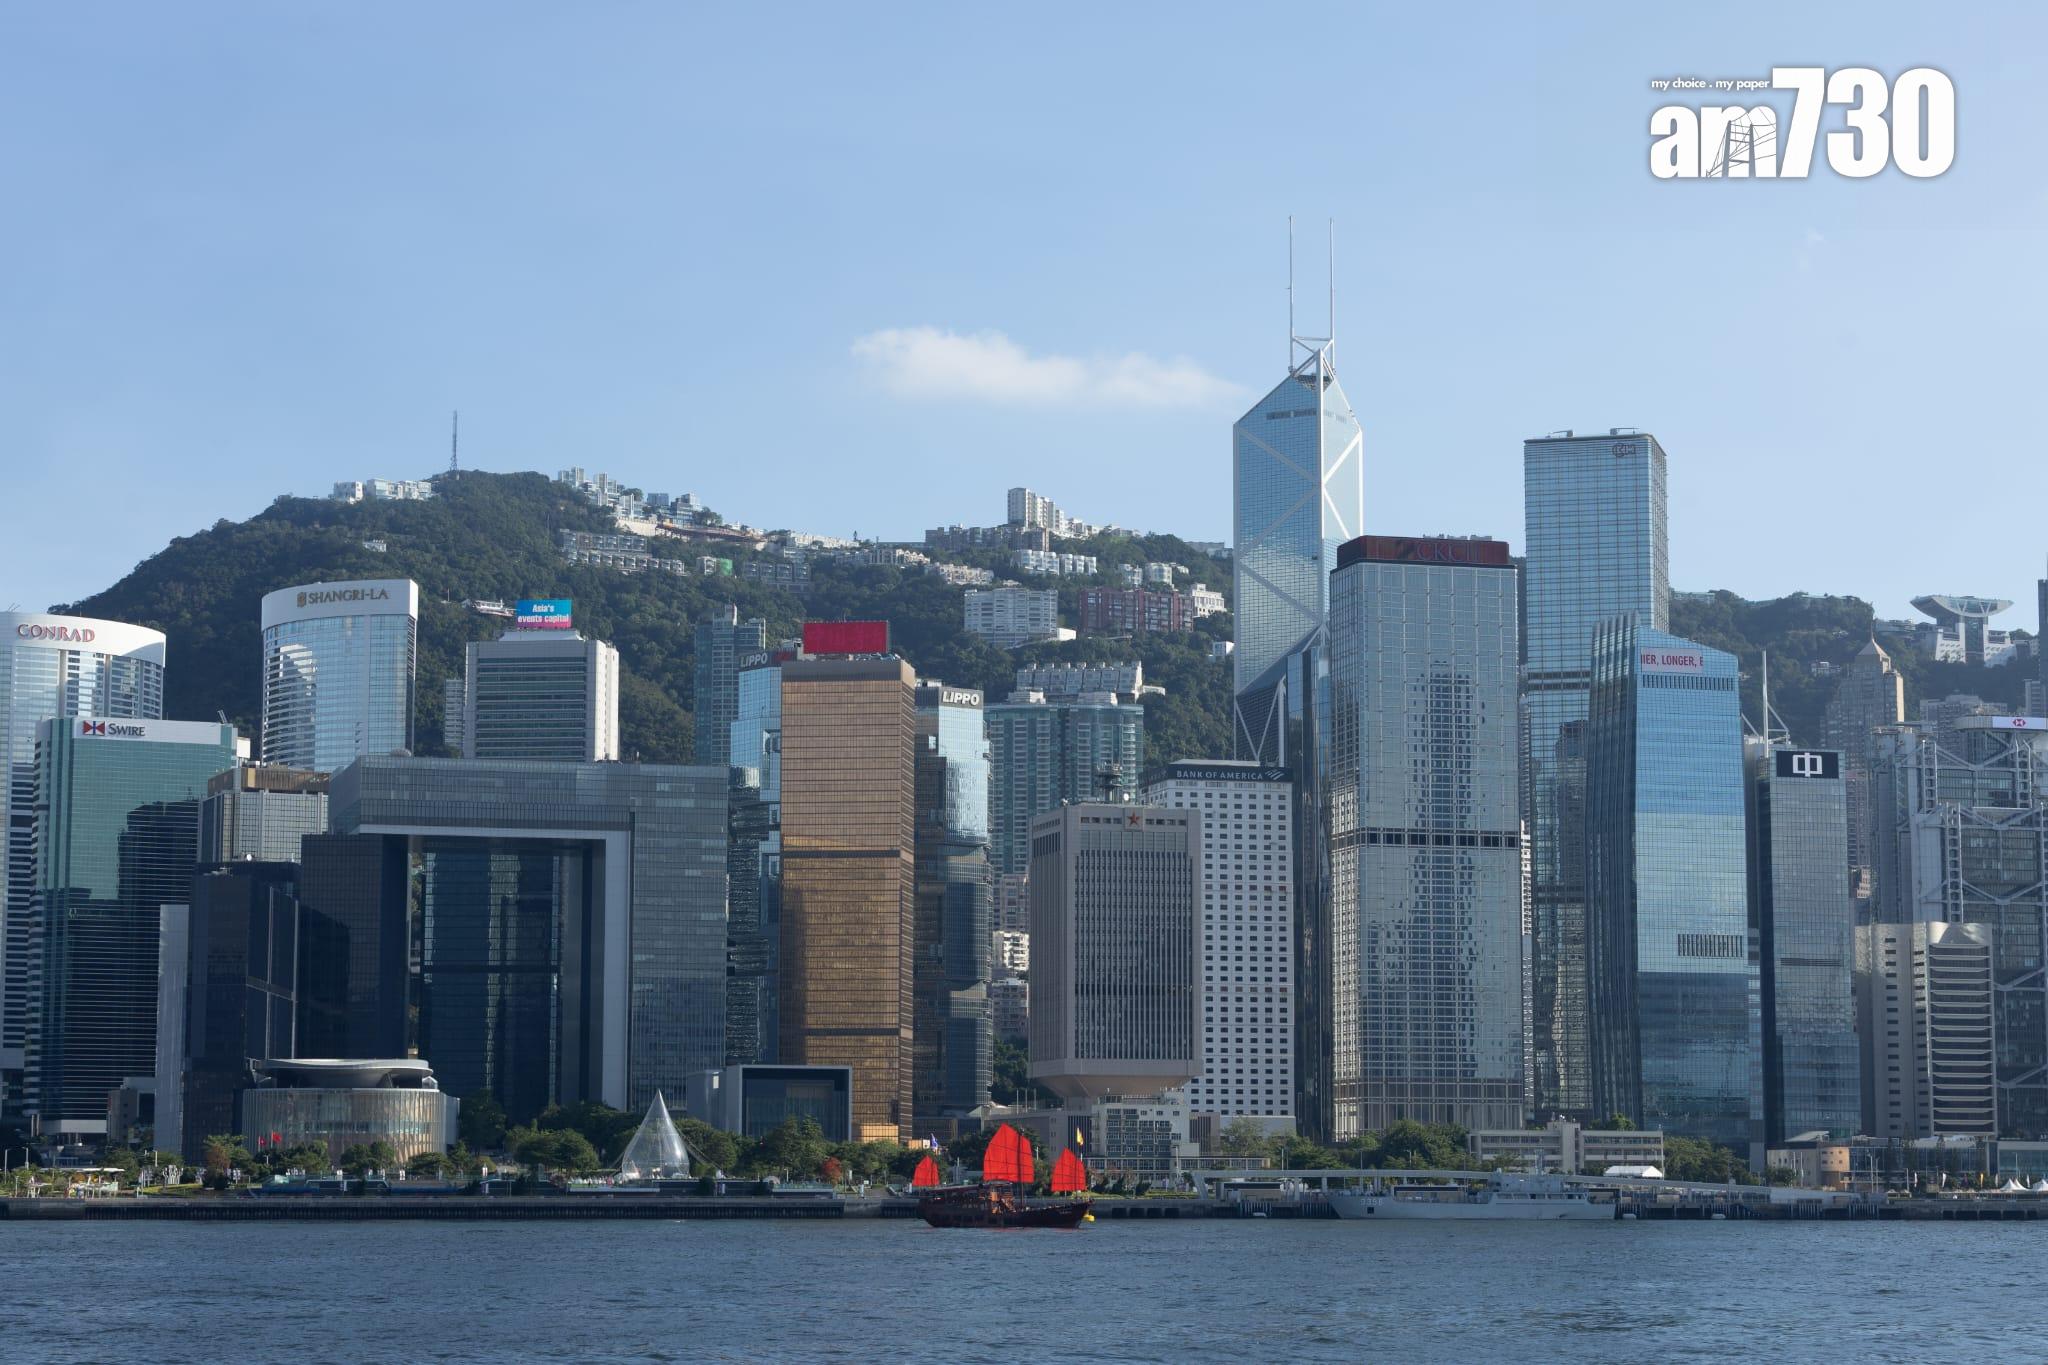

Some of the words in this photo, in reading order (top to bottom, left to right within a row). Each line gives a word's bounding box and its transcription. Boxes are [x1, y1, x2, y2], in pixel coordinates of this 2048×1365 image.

[308, 588, 389, 605] SHANGRI-LA
[532, 604, 555, 613] Asia's
[517, 615, 543, 623] events
[544, 614, 569, 623] capital
[17, 623, 96, 643] CONRAD
[740, 652, 768, 668] LIPPO
[1661, 655, 1698, 668] LONGER,
[942, 691, 980, 706] LIPPO
[1176, 770, 1203, 779] BANK
[1205, 771, 1218, 779] OF
[1220, 772, 1263, 780] AMERICA
